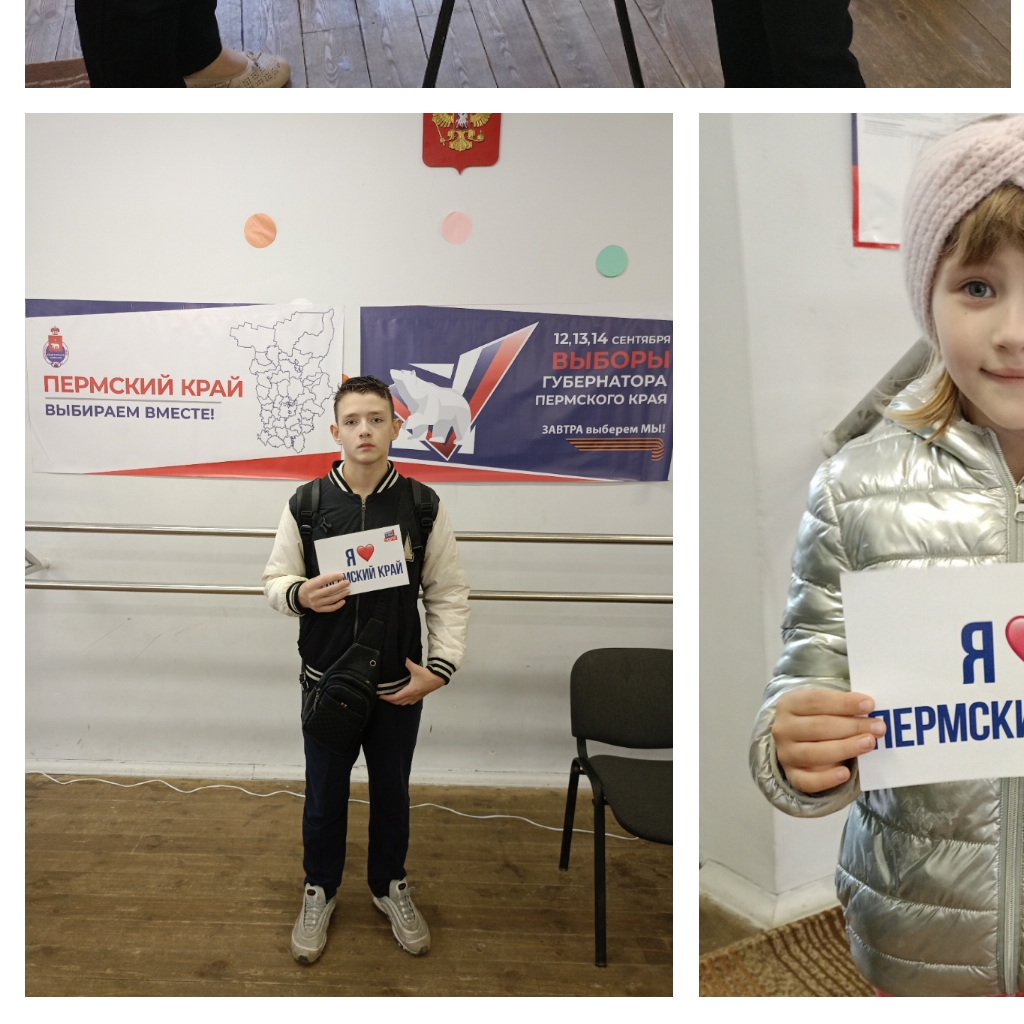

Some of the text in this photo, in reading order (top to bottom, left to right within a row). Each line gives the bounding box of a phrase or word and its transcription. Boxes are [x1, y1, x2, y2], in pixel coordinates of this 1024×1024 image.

[612, 335, 671, 345] СЕНТЯБРЯ
[552, 350, 671, 370] ВЫБОРЫ
[43, 374, 244, 398] ПЕРМСКИЙ КРАЙ
[542, 374, 667, 388] ГУБЕРНАТОРА
[535, 393, 667, 406] ПЕРМСКОГО КРАЯ
[45, 404, 215, 420] ВЫБИРАЕМ ВМЕСТЕ!
[542, 423, 666, 436] ЗАВТРА выберем МЫ!
[345, 548, 357, 567] Я
[377, 560, 404, 578] КРАЙ
[960, 621, 996, 685] Я
